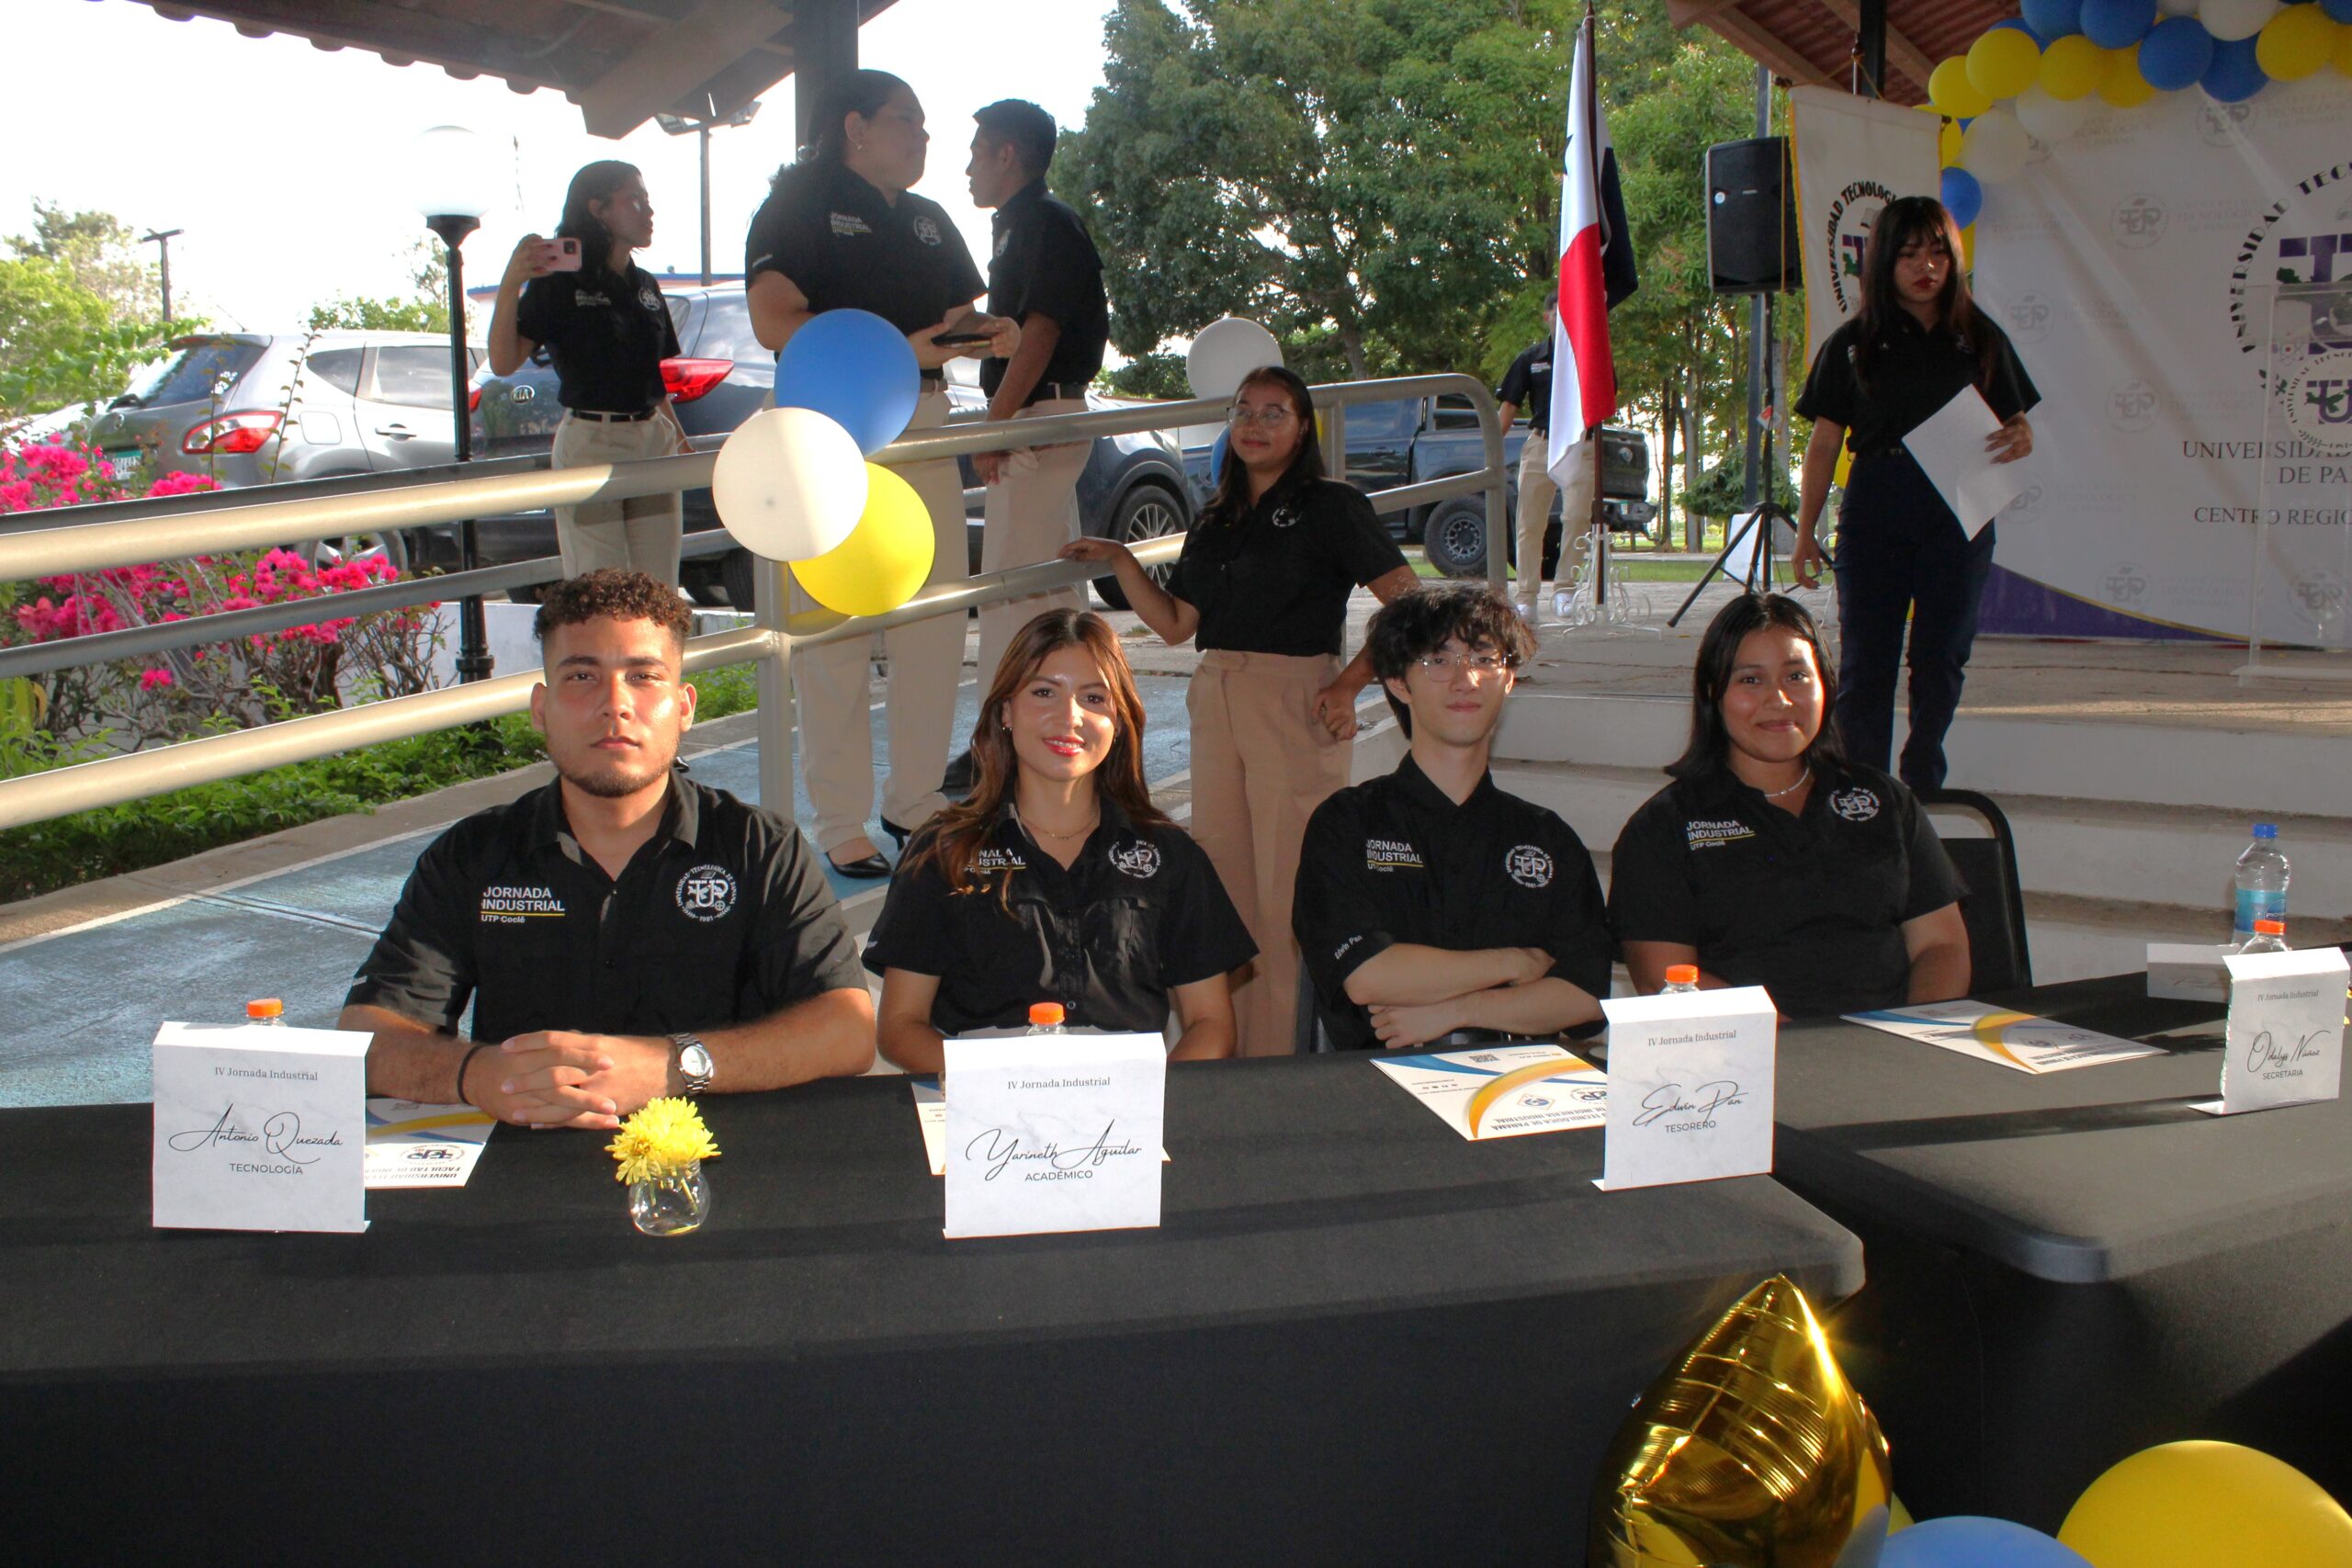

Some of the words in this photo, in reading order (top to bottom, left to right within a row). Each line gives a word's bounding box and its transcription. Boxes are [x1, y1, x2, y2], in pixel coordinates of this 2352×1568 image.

[1827, 199, 1849, 313] UNIVERSIDAD
[2230, 198, 2290, 354] UNIVERSIDAD
[2294, 162, 2352, 196] TEC
[2182, 440, 2351, 459] UNIVESID
[2278, 466, 2312, 484] DE
[2318, 466, 2352, 484] PA
[1686, 819, 1740, 831] JORNADA
[1688, 827, 1755, 841] INDUSTRIAL
[1366, 839, 1413, 852] JORNADA
[1690, 841, 1704, 852] UTP
[1366, 849, 1423, 863] INDUSTRIAL
[482, 886, 552, 898] JORNADA
[481, 898, 566, 911] INDUSTRIAL
[481, 913, 499, 922] UTP
[2257, 994, 2265, 1002] IV
[2265, 991, 2289, 1001] Jornada
[2290, 989, 2319, 999] Industrial
[1648, 1037, 1657, 1046] IV
[1659, 1034, 1693, 1045] Jornada
[1695, 1030, 1737, 1042] Industrial
[215, 1066, 225, 1076] IV
[228, 1067, 267, 1078] Jornada
[269, 1068, 319, 1081] Industrial
[2262, 1068, 2303, 1080] SECRETARIA
[1008, 1080, 1019, 1089] IV
[1020, 1078, 1060, 1089] Jornada
[1062, 1077, 1111, 1088] Industrial
[1633, 1084, 1696, 1127] Edwin
[1665, 1120, 1716, 1133] TESORERO
[168, 1103, 259, 1152] Antonio
[264, 1111, 344, 1165] Quezada
[966, 1128, 1058, 1181] Yarineth
[1051, 1119, 1142, 1169] Aguilar
[229, 1163, 303, 1175] TECNOLOGÍA
[1024, 1168, 1093, 1182] ACADÉMICO
